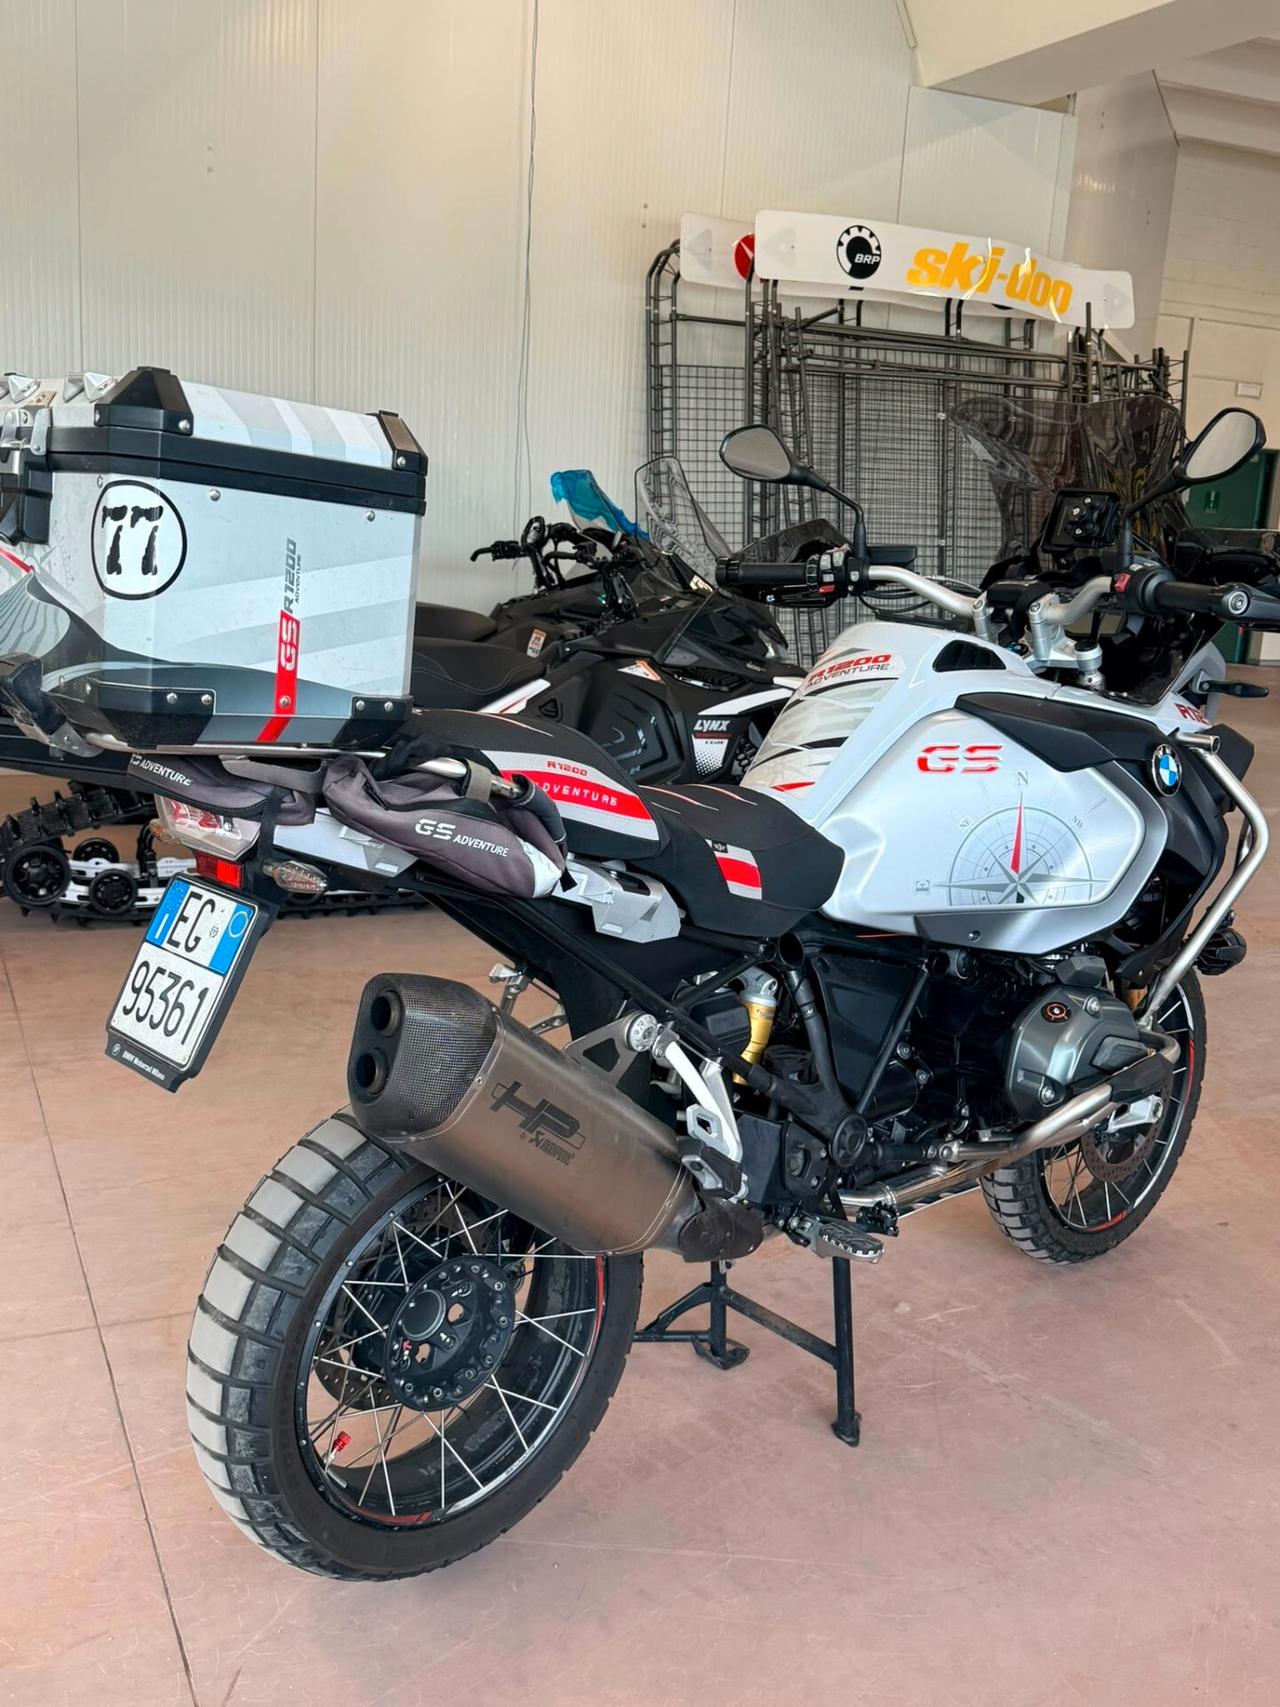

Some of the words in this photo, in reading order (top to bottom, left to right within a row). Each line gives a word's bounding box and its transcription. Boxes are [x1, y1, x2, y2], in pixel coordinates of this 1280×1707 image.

[854, 253, 880, 266] BRP
[905, 242, 1073, 316] ski-doo
[101, 505, 164, 576] 77
[284, 538, 297, 614] R1200
[280, 617, 297, 671] GS
[805, 663, 890, 691] ADVENTURE
[808, 654, 892, 684] R1200
[694, 720, 730, 732] LYNX
[139, 759, 192, 786] ADVENTURE
[546, 760, 588, 777] R1200
[917, 745, 1003, 774] GS
[1017, 771, 1028, 785] N
[535, 782, 618, 807] DVENTURE
[415, 818, 457, 840] GS
[453, 834, 510, 857] ADVENTURE
[166, 891, 216, 953] EG
[122, 960, 210, 1046] 95361
[489, 1081, 580, 1138] HP
